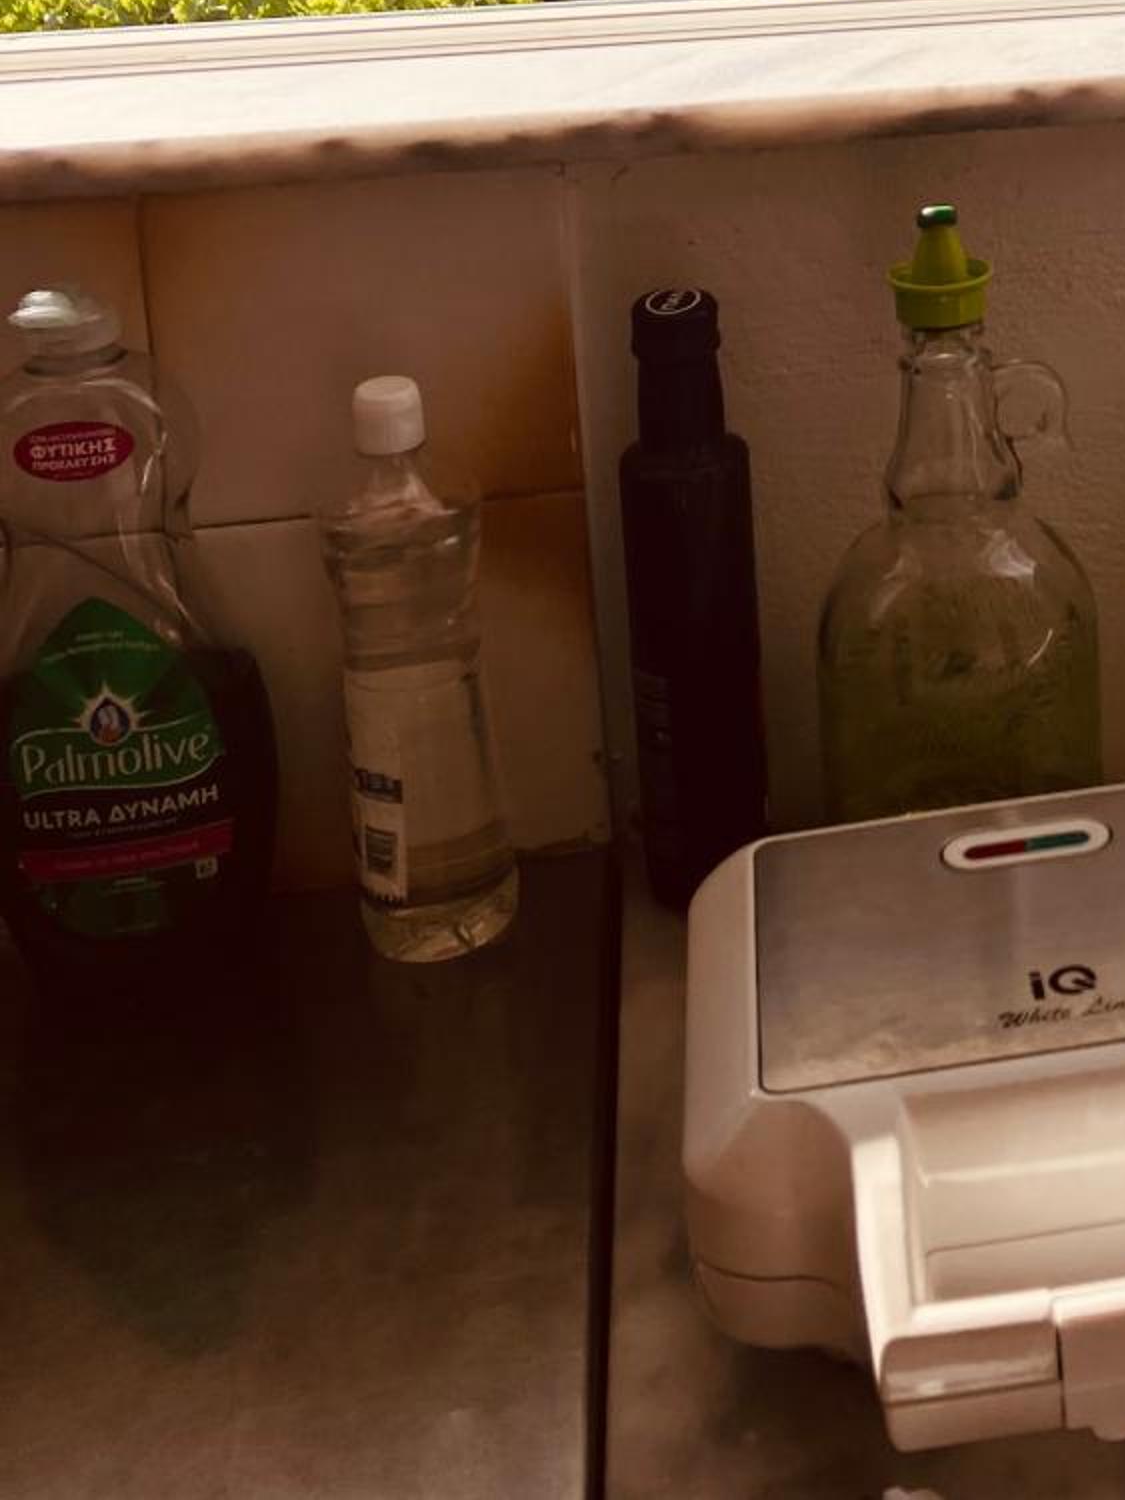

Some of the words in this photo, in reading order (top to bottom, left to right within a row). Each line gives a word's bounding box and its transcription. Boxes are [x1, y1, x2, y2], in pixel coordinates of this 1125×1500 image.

[30, 436, 118, 460] ΦΥΤΙΚΗΣ
[20, 730, 211, 785] Palmolive
[22, 807, 102, 831] ULTRA
[107, 783, 221, 824] ΔΥΝΑΜΗ
[997, 1007, 1072, 1029] White
